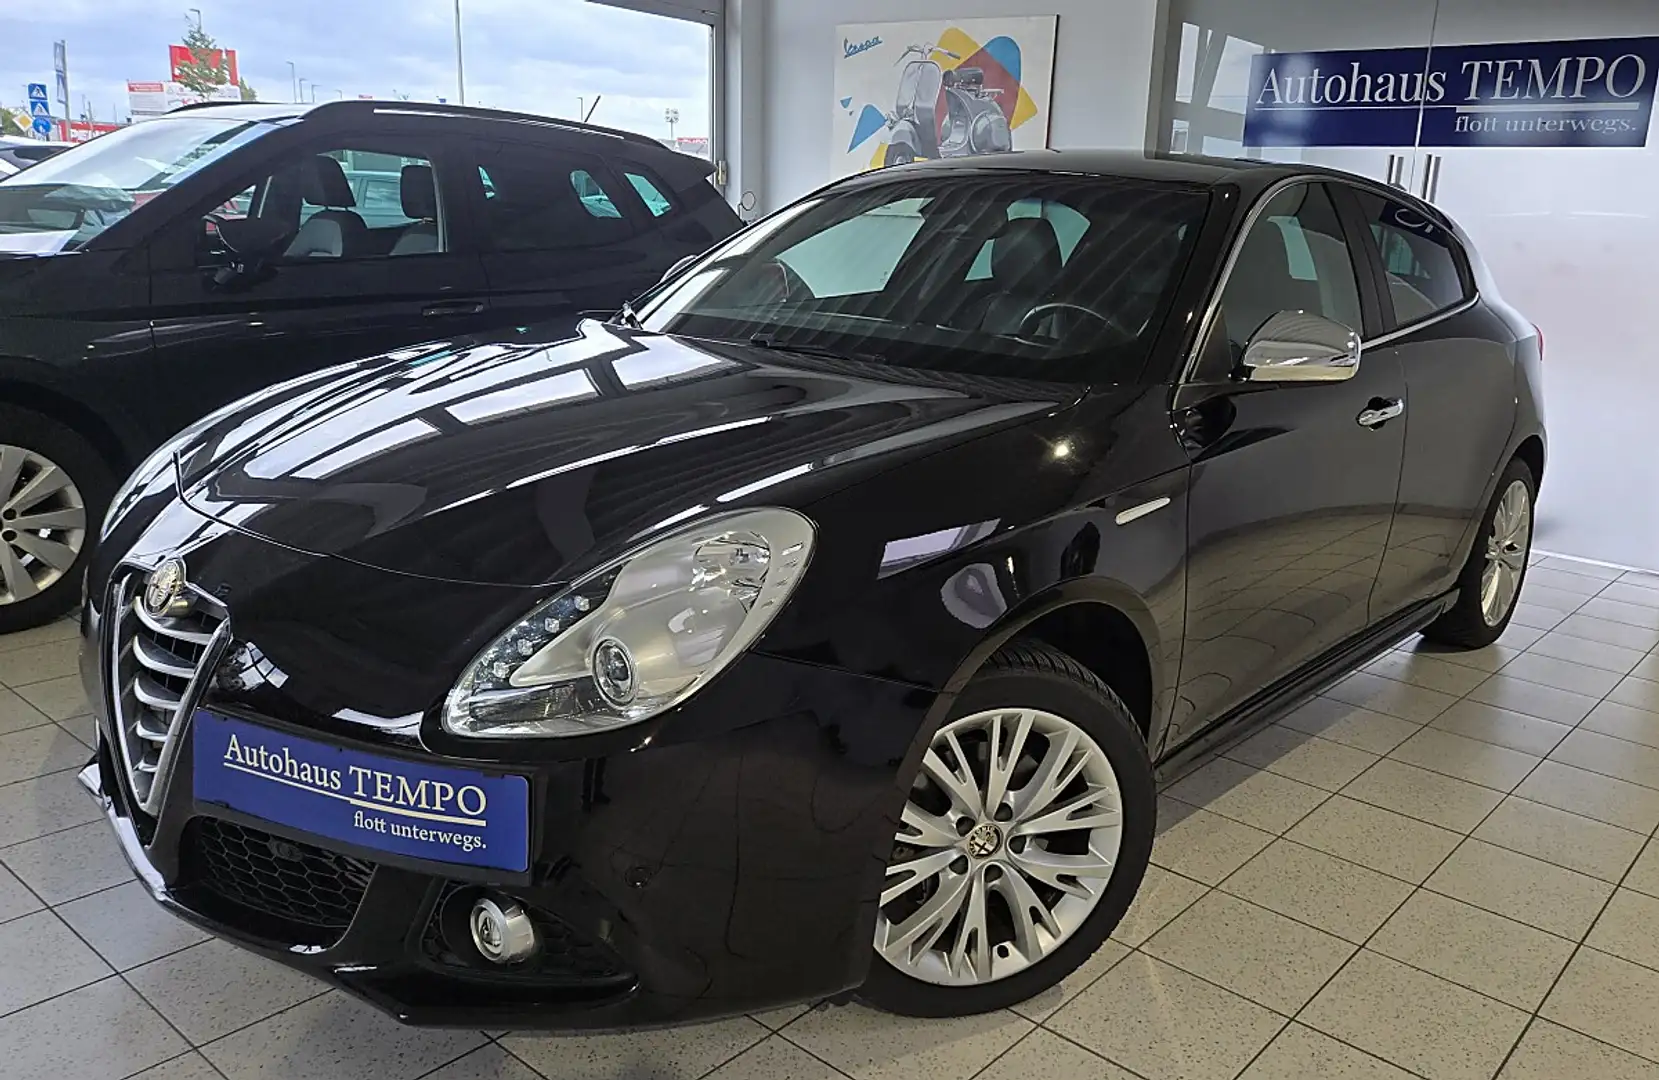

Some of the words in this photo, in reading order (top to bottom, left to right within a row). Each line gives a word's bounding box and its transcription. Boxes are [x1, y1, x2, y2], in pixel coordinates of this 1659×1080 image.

[1256, 62, 1447, 104] Autohaus
[1461, 54, 1647, 101] TEMPO
[1454, 114, 1499, 132] flott
[1505, 114, 1636, 133] unterwegs.
[223, 734, 342, 790] Autohaus
[349, 765, 487, 816] TEMPO
[353, 810, 387, 834] flott
[391, 824, 487, 852] unterwegs.
